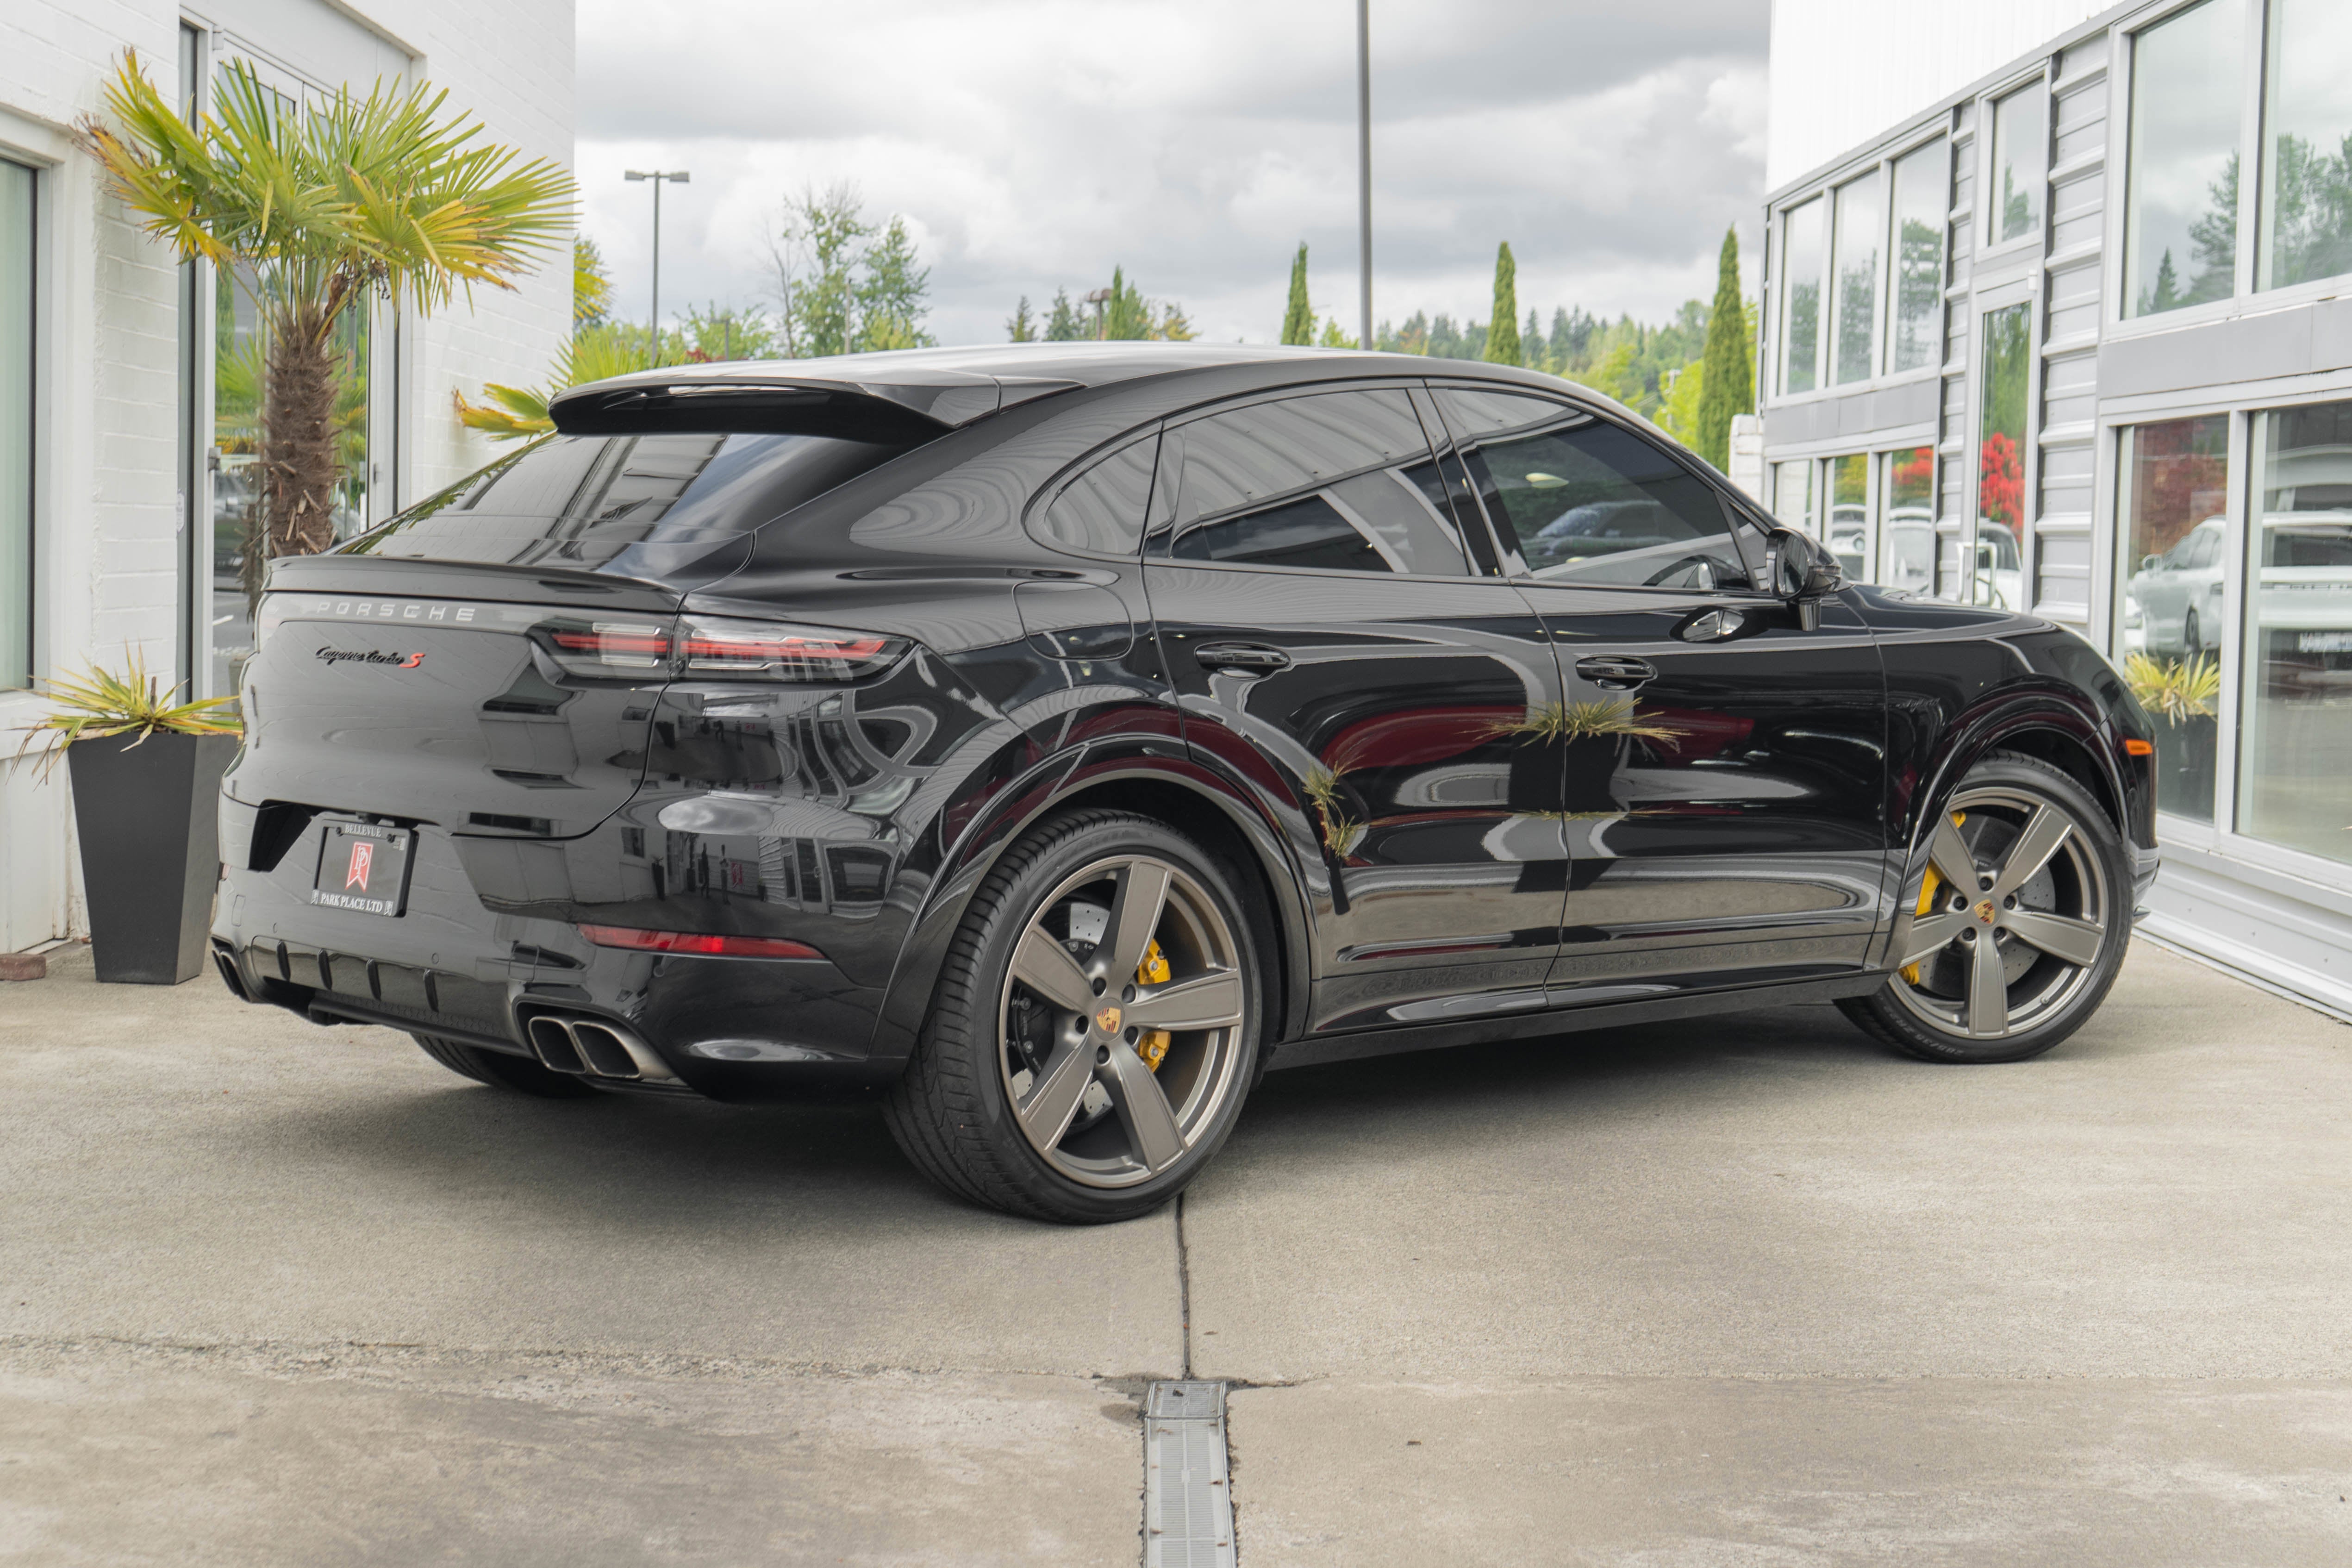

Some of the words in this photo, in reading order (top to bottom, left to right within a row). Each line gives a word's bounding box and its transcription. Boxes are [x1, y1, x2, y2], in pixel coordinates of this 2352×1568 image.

[317, 602, 475, 621] PORSCHE
[316, 646, 365, 665] Cayenne
[399, 653, 425, 668] S
[345, 824, 382, 837] BELLEVUE
[320, 893, 341, 906] PARK
[340, 895, 366, 910] PLACE
[365, 900, 383, 912] LTD
